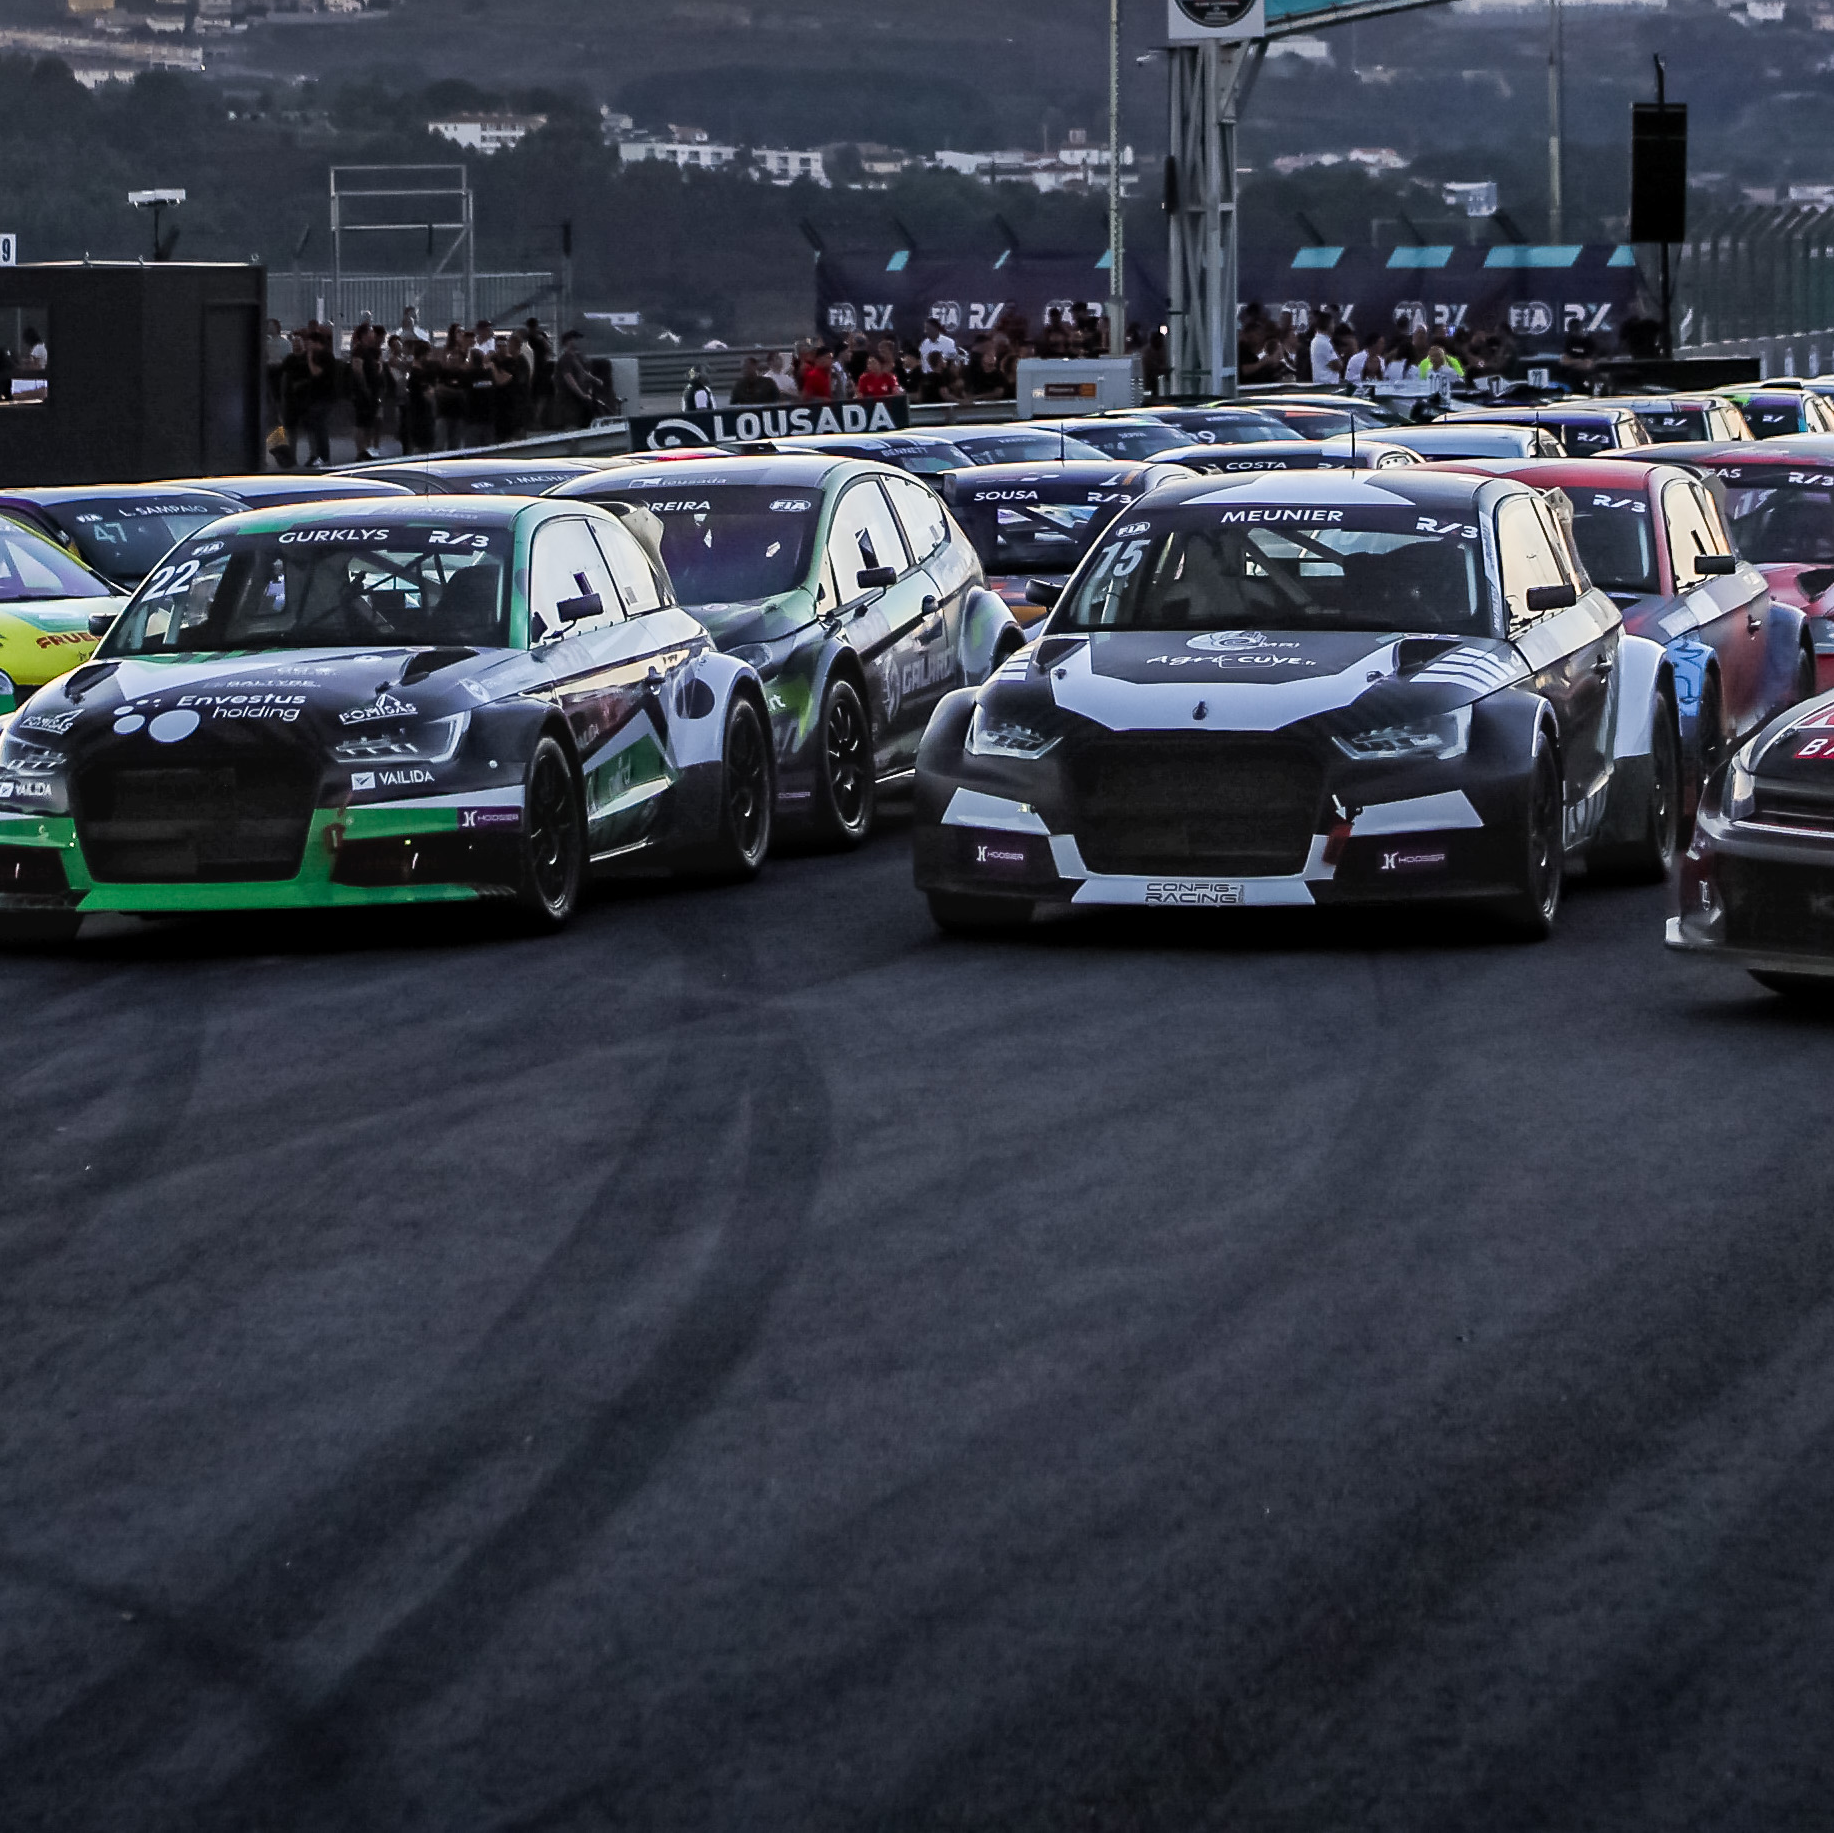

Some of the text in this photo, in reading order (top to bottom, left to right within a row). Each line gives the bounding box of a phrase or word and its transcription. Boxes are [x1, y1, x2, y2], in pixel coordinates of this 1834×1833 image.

[713, 401, 898, 442] LOUSADA
[1225, 460, 1288, 471] COSTA
[973, 489, 1039, 502] SOUSA
[769, 499, 812, 513] FIA
[1220, 509, 1344, 524] MEUNIER
[93, 522, 128, 544] 47
[278, 528, 391, 545] GURKLYS
[1115, 521, 1151, 538] FIA
[191, 539, 225, 557] FIA
[1099, 539, 1152, 578] 15
[141, 559, 203, 603] 22
[212, 704, 303, 723] holding
[1145, 882, 1238, 894] CONFIG-
[1145, 894, 1239, 904] RACING
